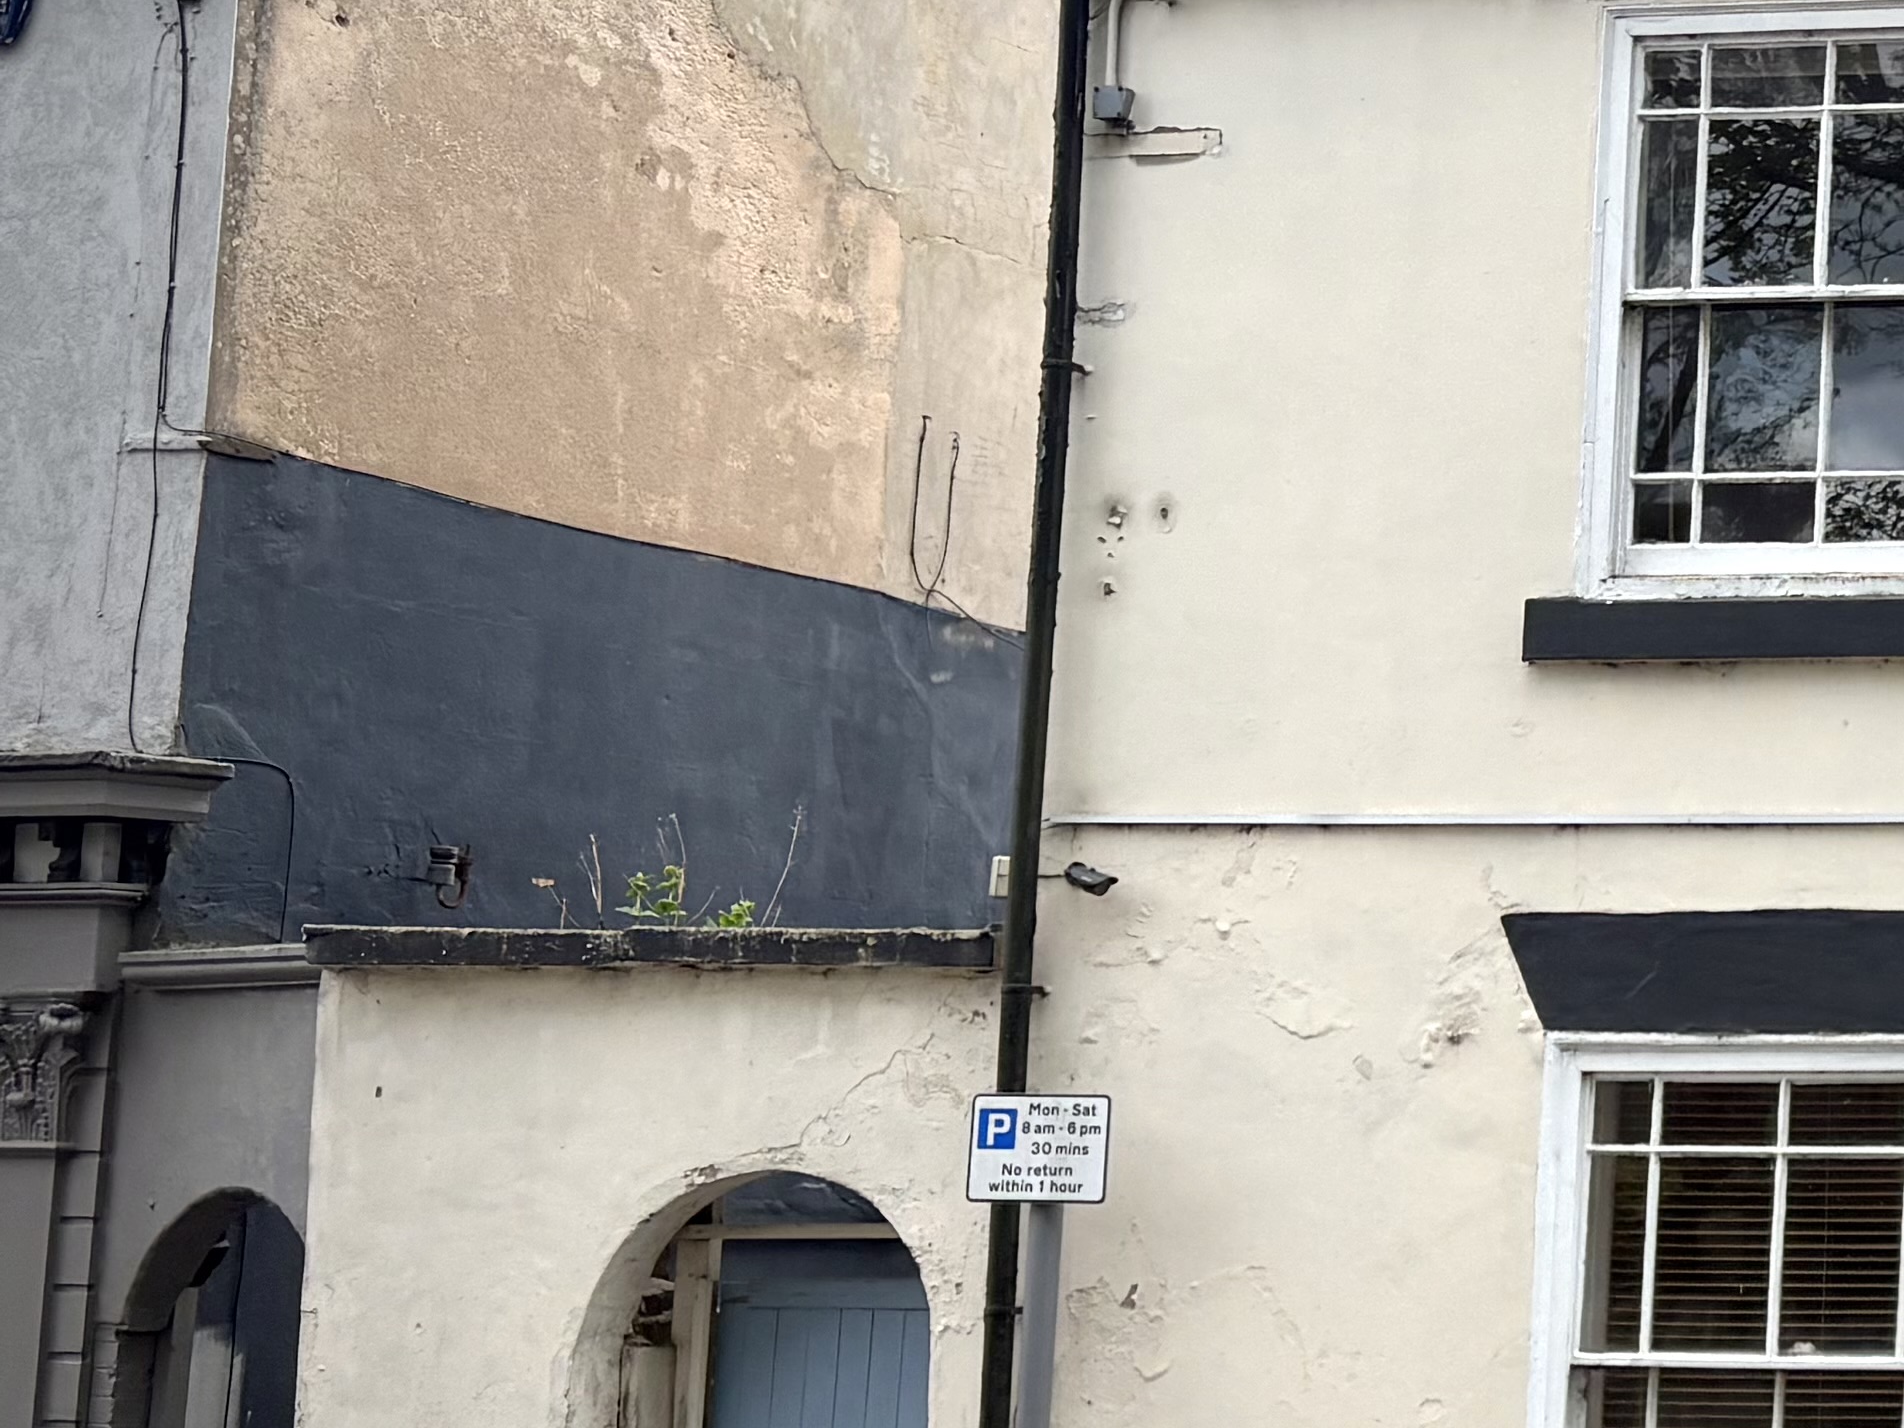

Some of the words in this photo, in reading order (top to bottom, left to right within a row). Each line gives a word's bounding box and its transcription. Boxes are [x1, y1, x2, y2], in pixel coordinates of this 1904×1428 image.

[1028, 1103, 1060, 1117] Mon
[1072, 1103, 1097, 1117] Sat
[986, 1113, 1011, 1147] P
[1031, 1142, 1052, 1156] 30
[1055, 1142, 1090, 1156] mins
[1001, 1163, 1022, 1176] No
[1026, 1163, 1073, 1177] return
[988, 1179, 1033, 1193] within
[1039, 1180, 1044, 1193] 1
[1049, 1180, 1084, 1193] hour
